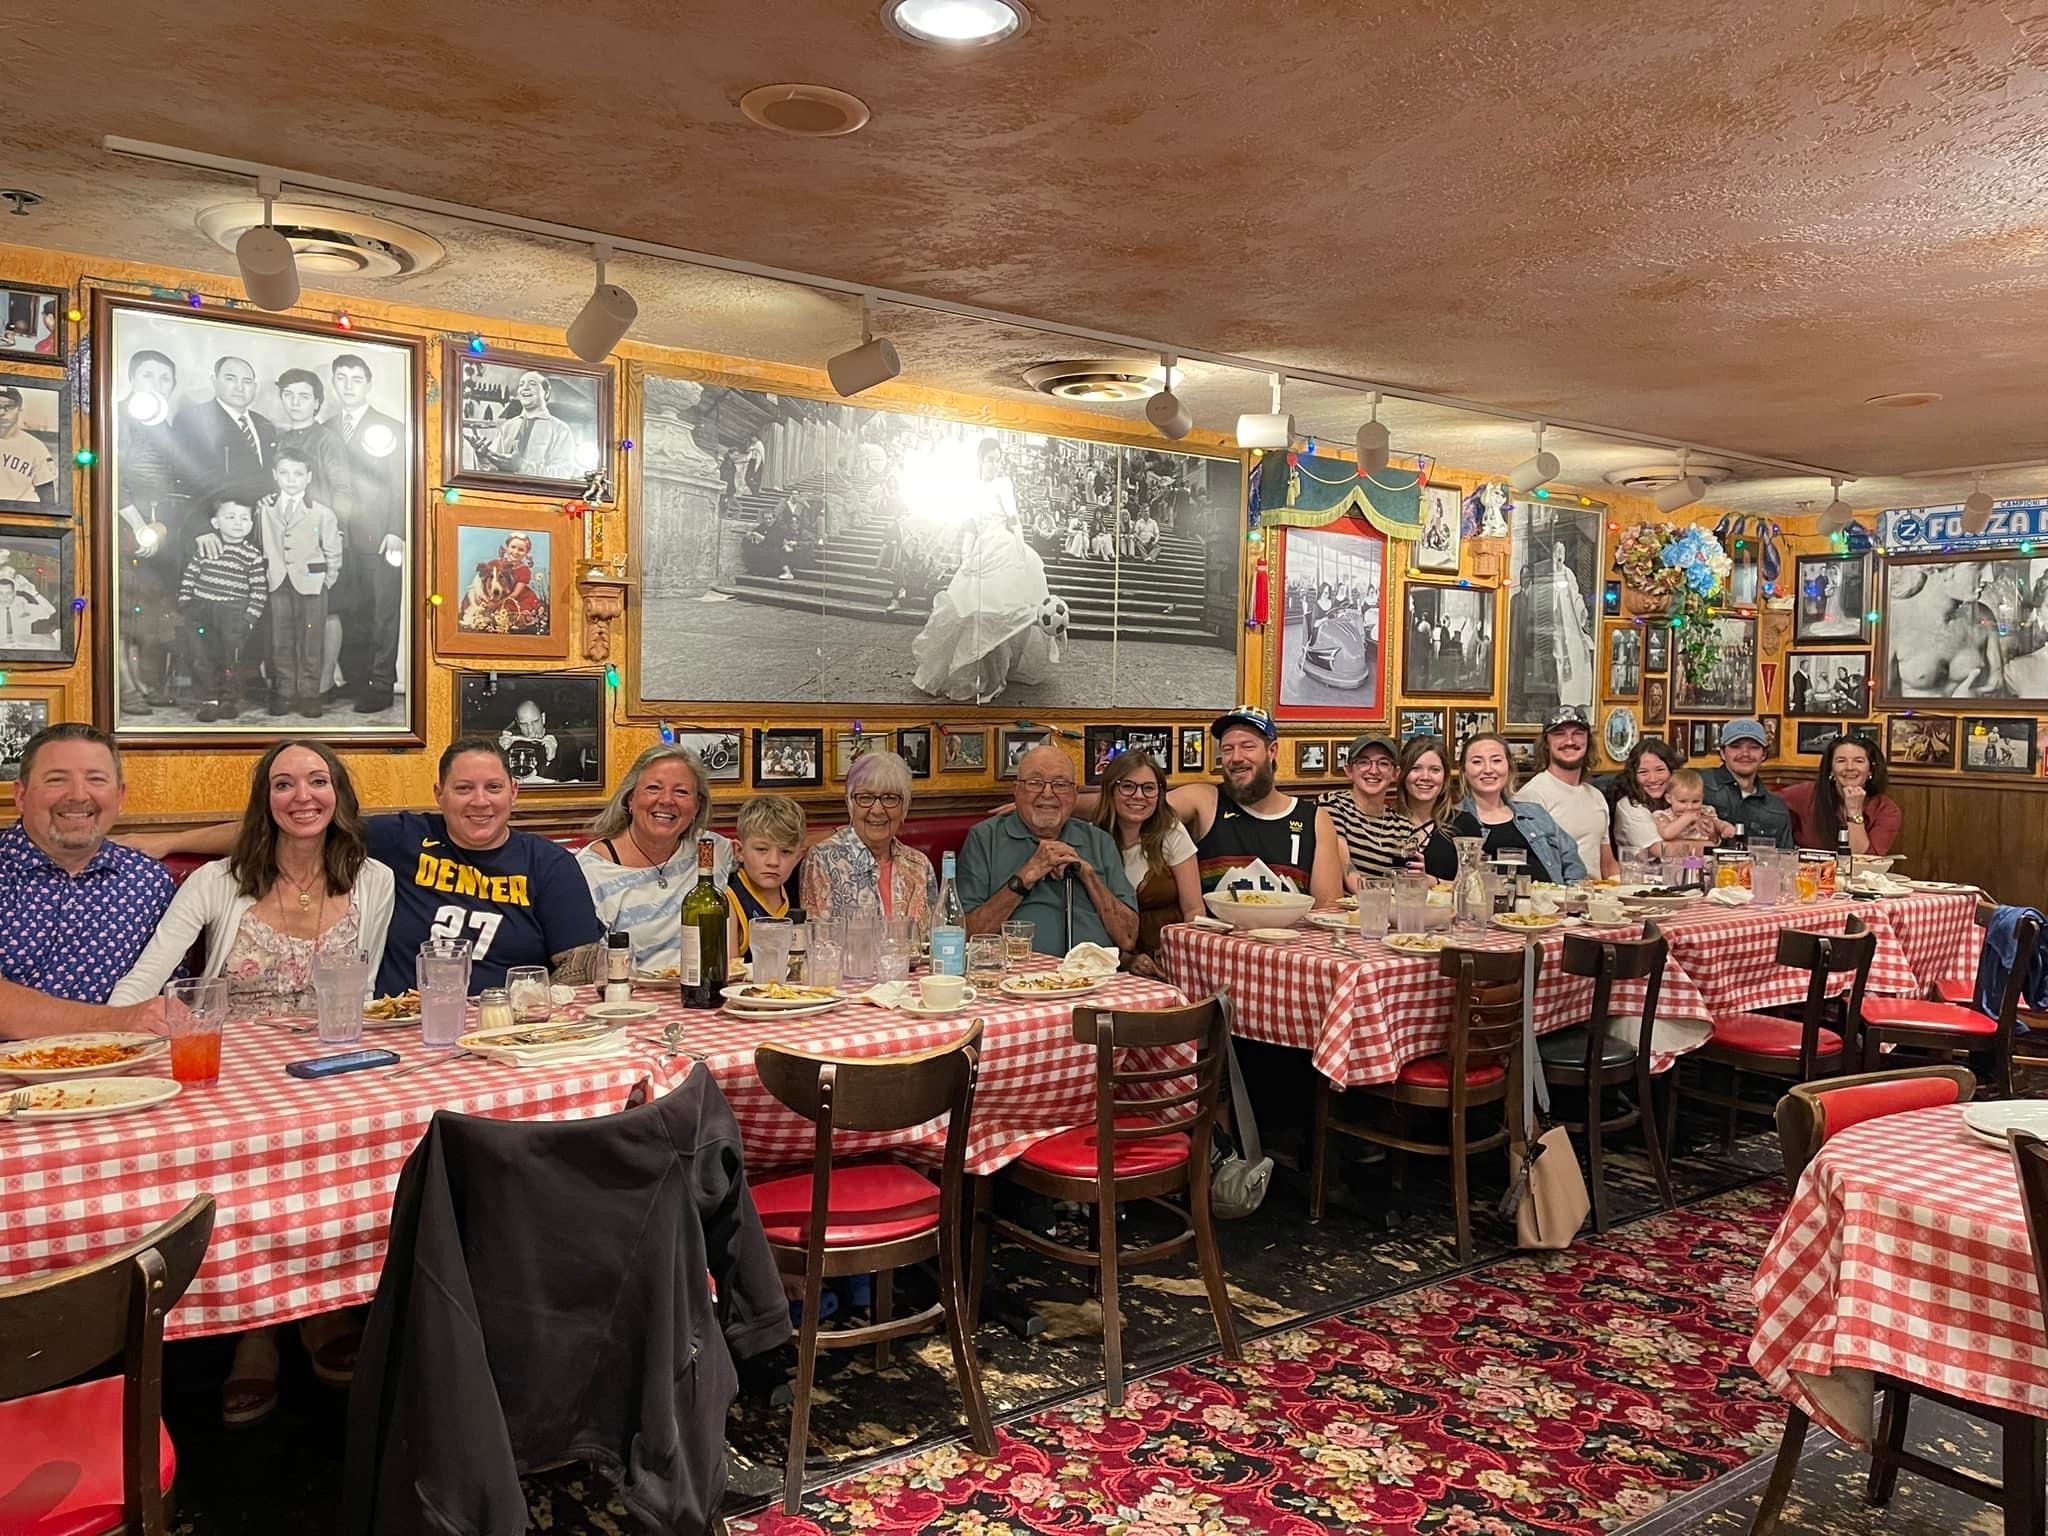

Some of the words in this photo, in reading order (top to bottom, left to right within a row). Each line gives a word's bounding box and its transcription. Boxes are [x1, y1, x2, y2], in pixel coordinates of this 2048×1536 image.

[1929, 511, 2030, 539] FOZA
[1290, 834, 1300, 864] 1
[415, 852, 530, 907] DENVER
[430, 905, 504, 961] 27
